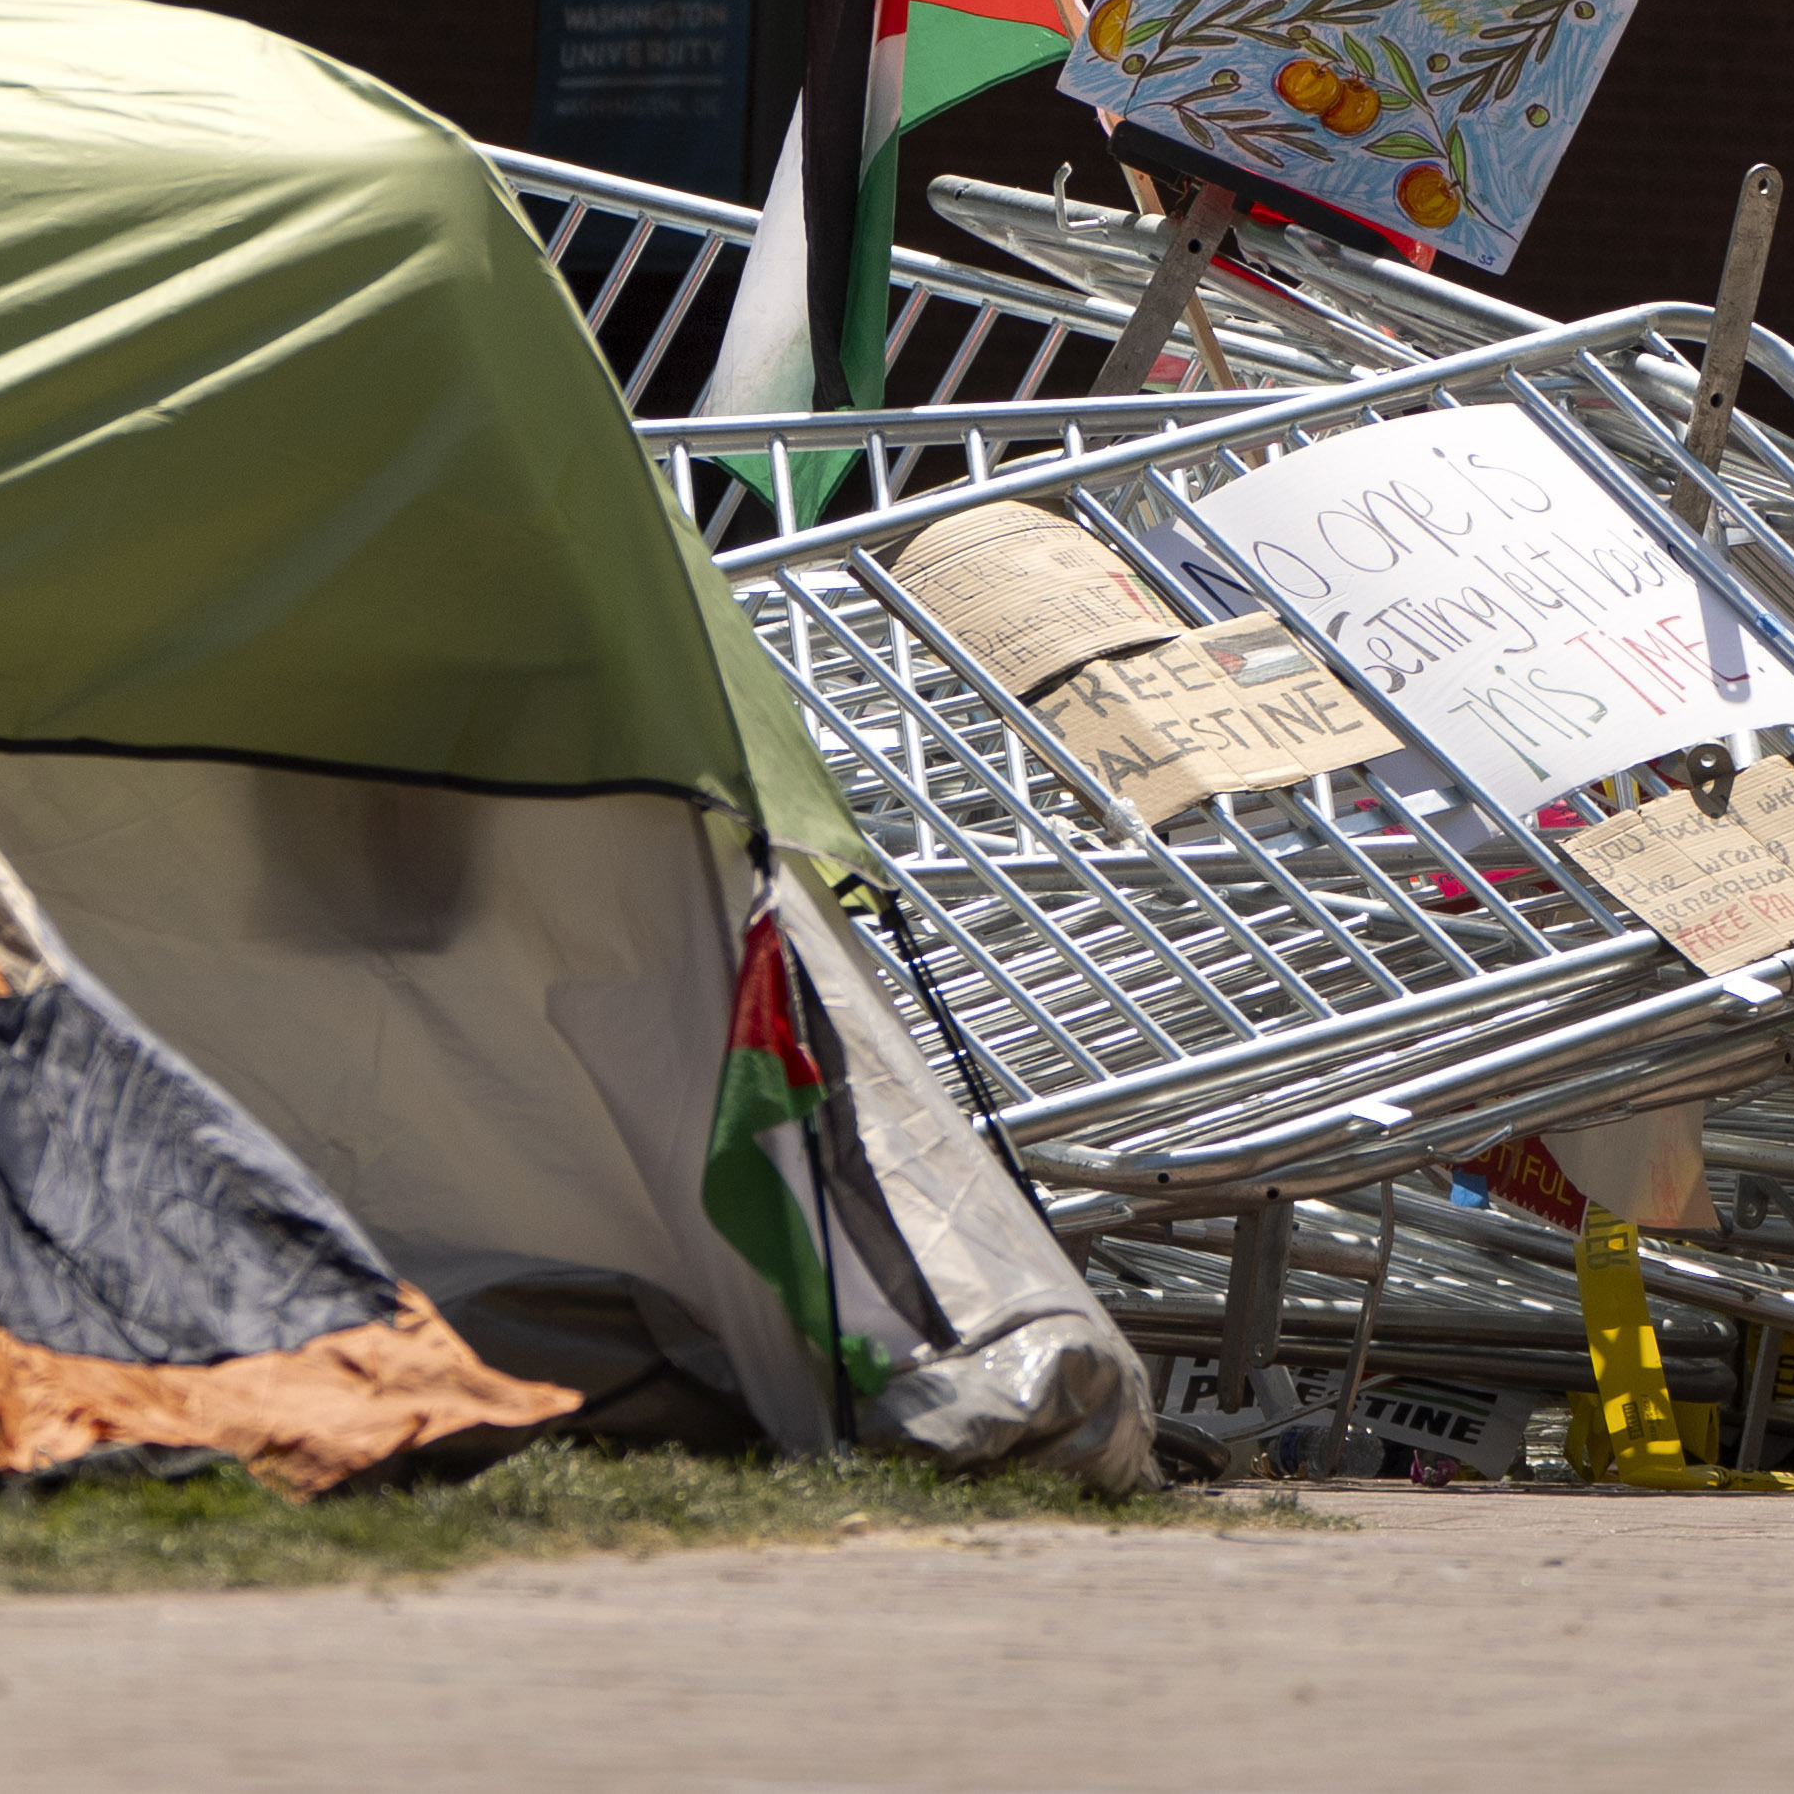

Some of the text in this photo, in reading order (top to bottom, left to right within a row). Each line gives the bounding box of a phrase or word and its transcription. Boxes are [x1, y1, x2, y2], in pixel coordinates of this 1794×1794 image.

[564, 2, 728, 31] WASHINGTON
[559, 39, 726, 70] UNIVERSITY
[1431, 446, 1552, 521] is
[1031, 641, 1217, 741] FREE
[1617, 839, 1790, 905] the wrong
[1676, 903, 1752, 960] FREE
